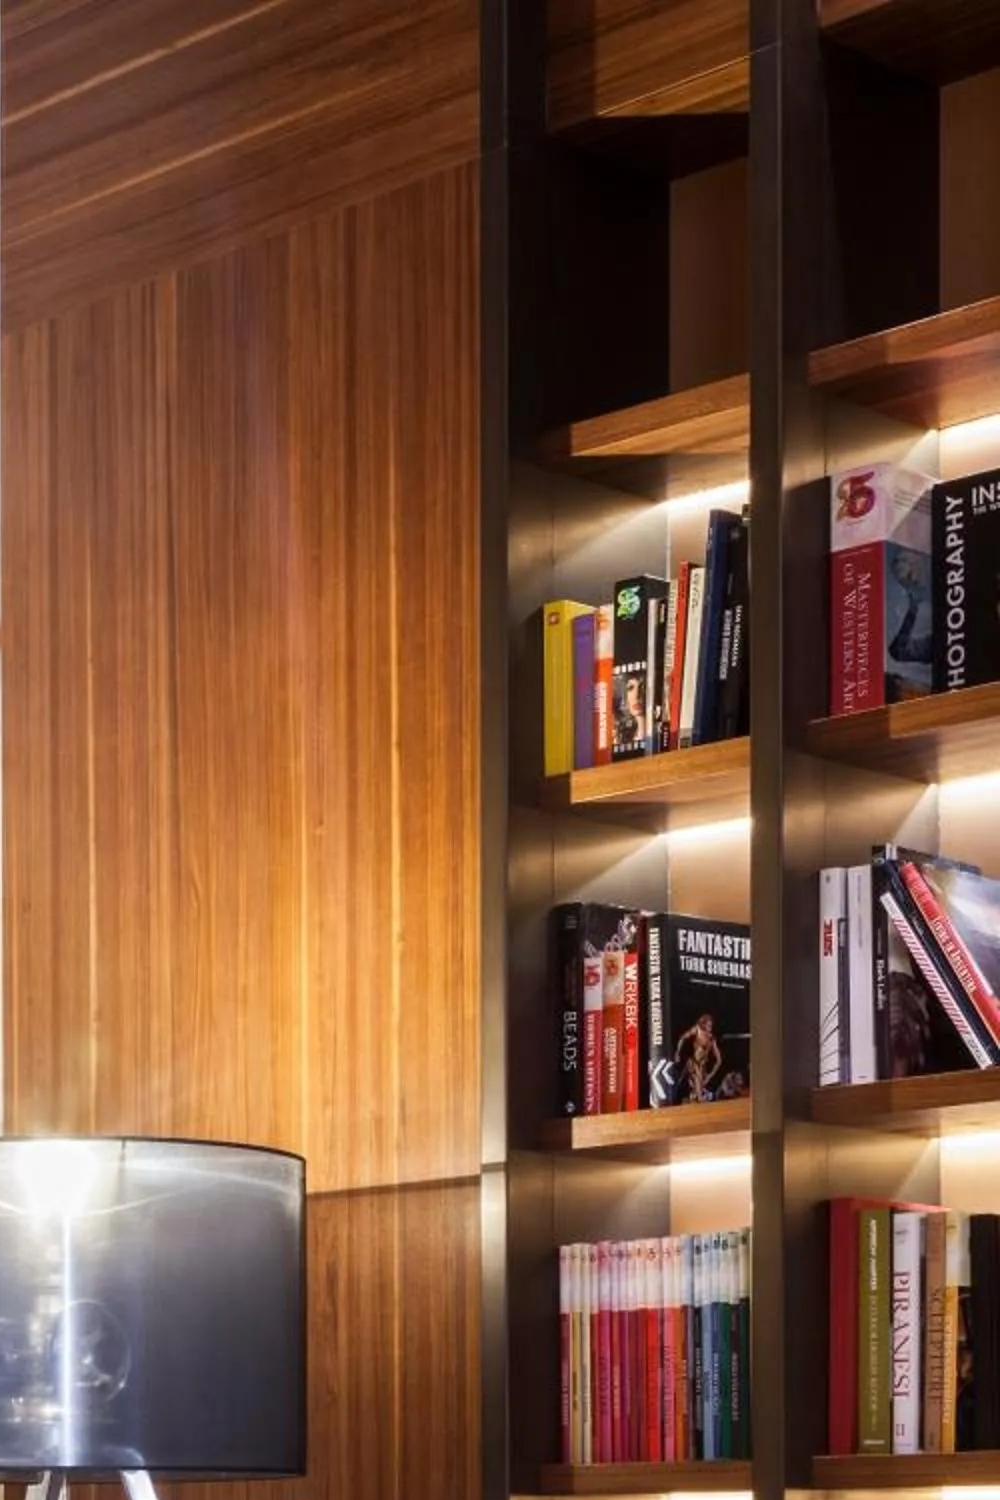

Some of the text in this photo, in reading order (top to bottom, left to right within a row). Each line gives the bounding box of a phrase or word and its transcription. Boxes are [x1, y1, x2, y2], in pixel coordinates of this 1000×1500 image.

[842, 563, 857, 713] OF WESTERN ART
[857, 572, 871, 697] MASTERPIECES
[946, 496, 965, 690] HOTOGRAPHY
[562, 1010, 578, 1072] BEADS
[625, 963, 638, 1030] WRKBK
[892, 1270, 911, 1399] PIRANESI
[928, 1288, 945, 1405] SCULPTURE
